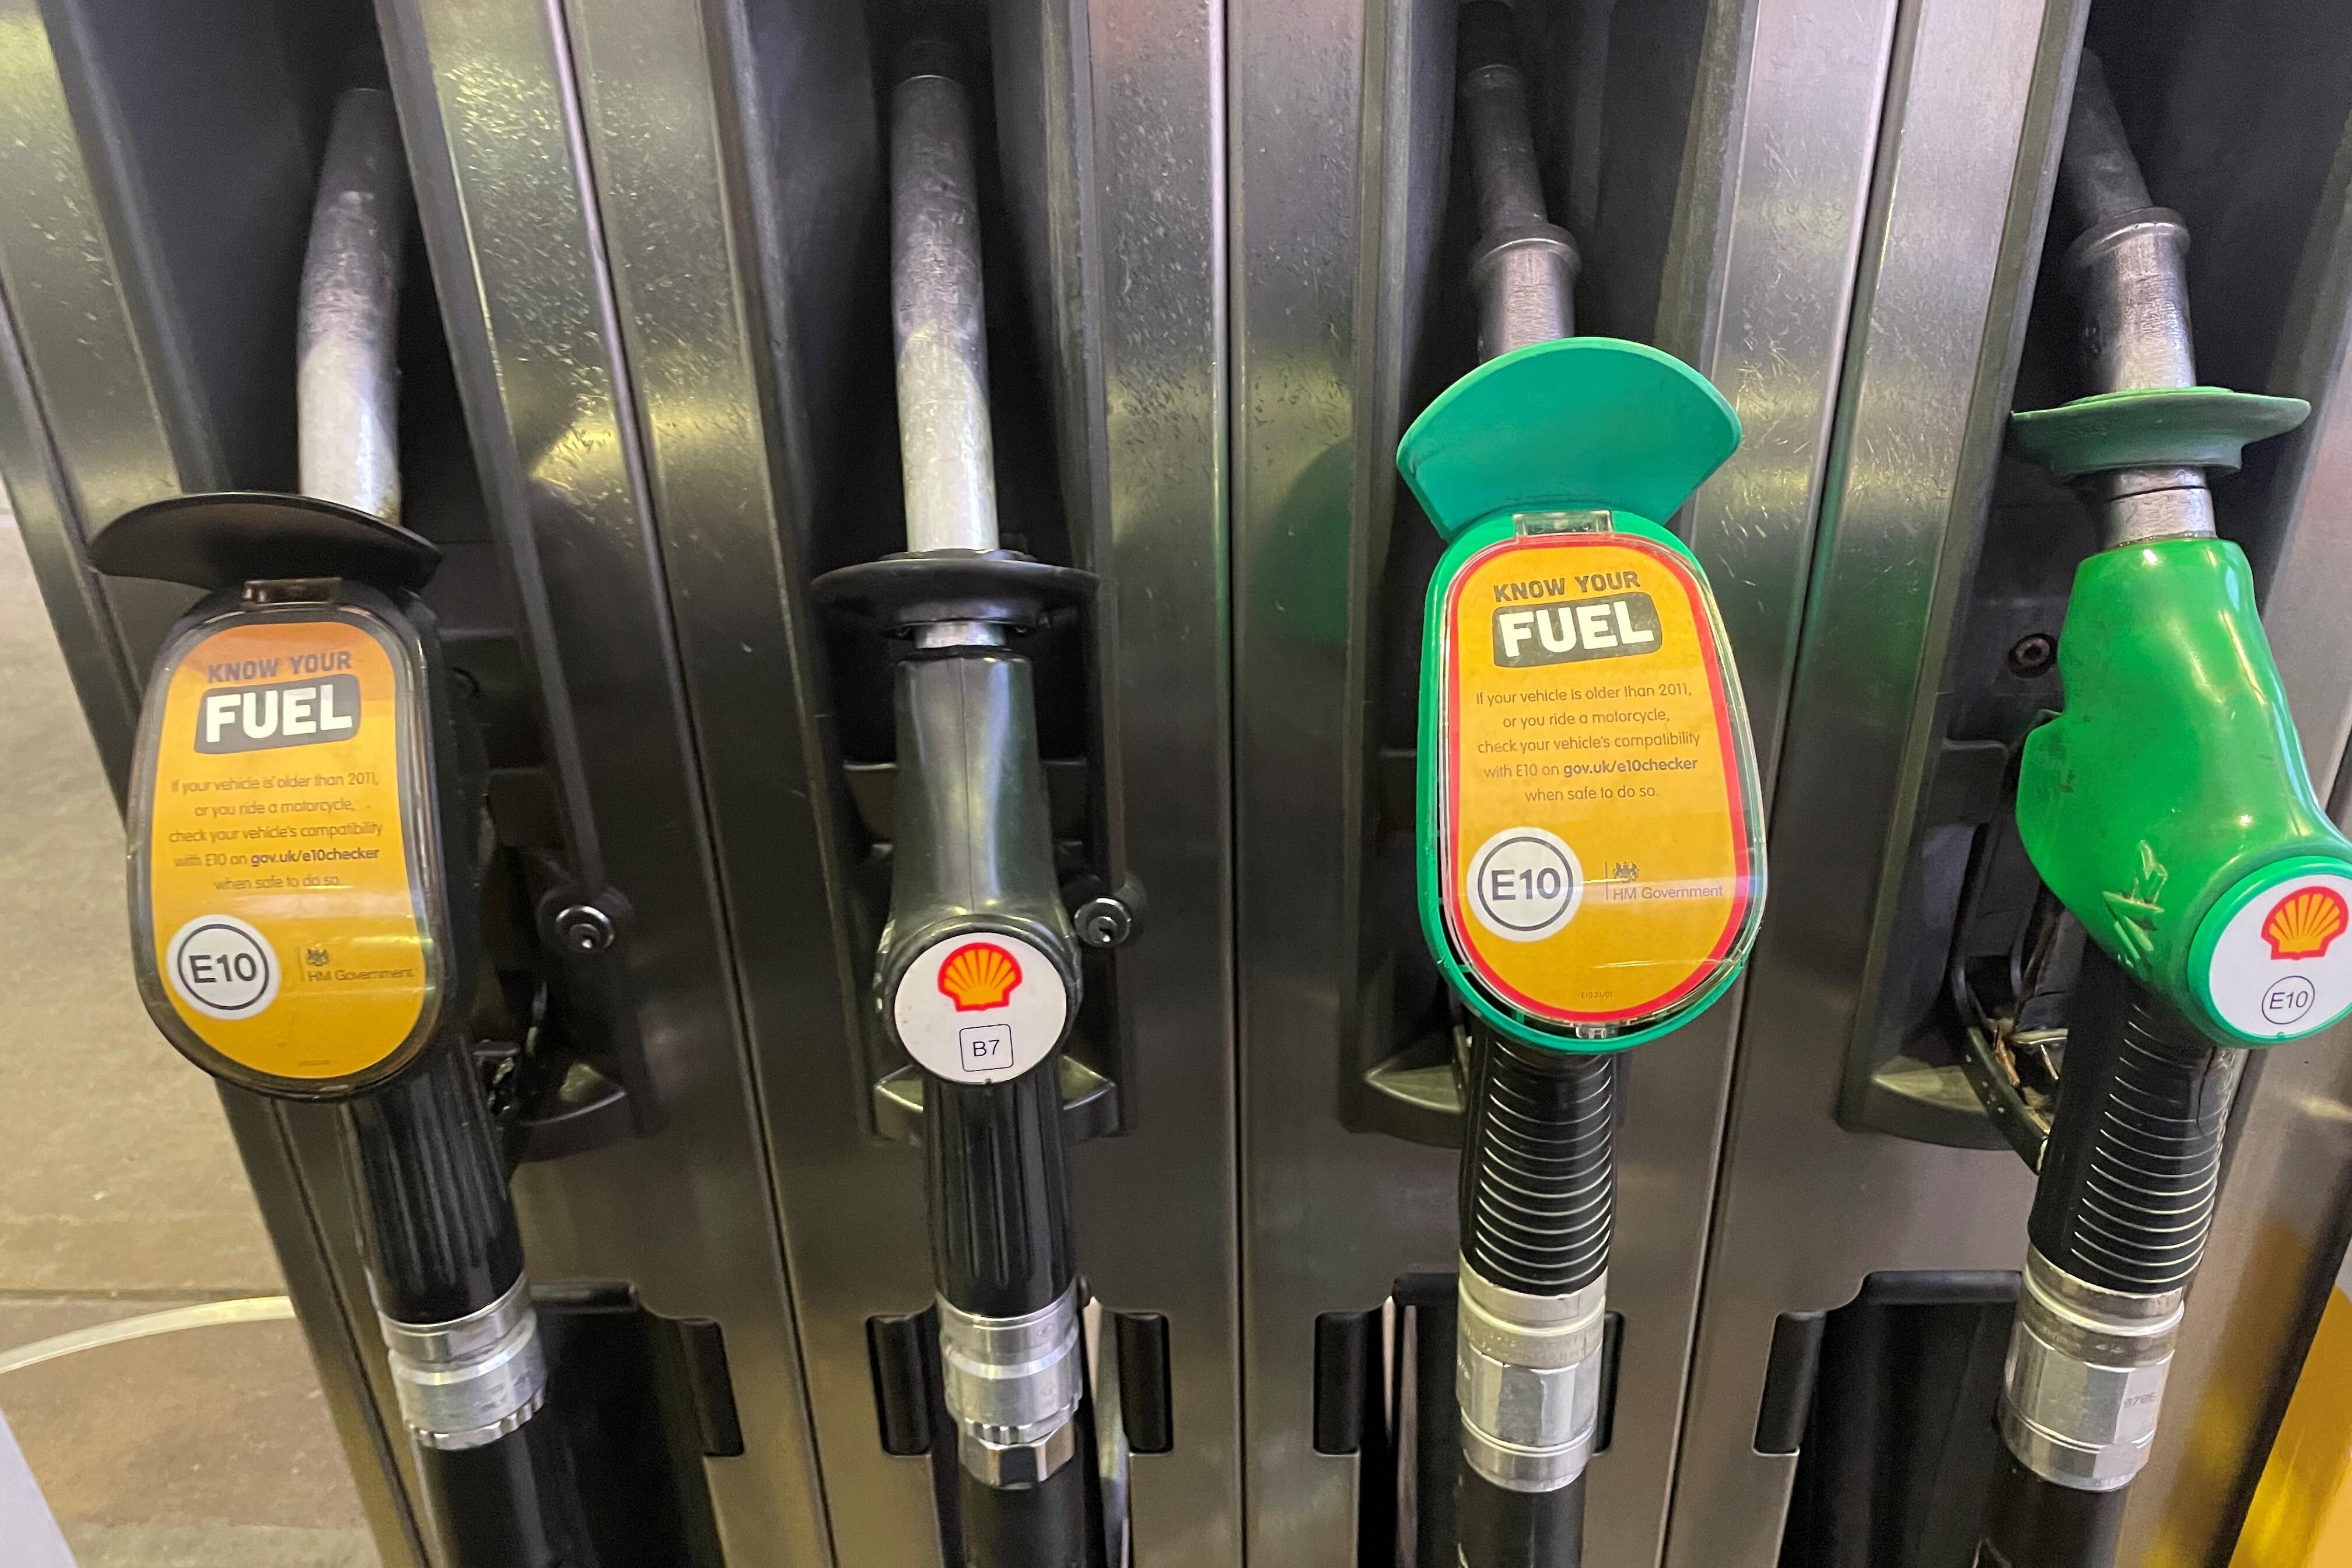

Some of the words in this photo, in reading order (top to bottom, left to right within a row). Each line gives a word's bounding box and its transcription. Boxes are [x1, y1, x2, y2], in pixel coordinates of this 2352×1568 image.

[1493, 578, 1566, 603] KNOW
[1574, 570, 1641, 594] YOUR
[1498, 600, 1654, 657] FUEL
[207, 658, 279, 684] KNOW
[291, 650, 352, 674] YOUR
[1476, 691, 1484, 705] If
[1486, 693, 1517, 707] your
[1520, 688, 1567, 702] vehicle
[1570, 688, 1582, 700] is
[1586, 686, 1620, 699] older
[1624, 685, 1655, 698] than
[1658, 682, 1692, 696] 2011,
[206, 684, 352, 743] FUEL
[1503, 717, 1517, 727] or
[1520, 716, 1545, 730] you
[1549, 712, 1576, 725] ride
[1578, 714, 1588, 724] a
[1592, 708, 1670, 724] motorcycle,
[1478, 738, 1518, 753] check
[1520, 741, 1550, 754] your
[1553, 735, 1610, 750] vehicle's
[1614, 731, 1700, 749] compatibility
[1483, 764, 1512, 778] with
[1516, 764, 1538, 777] E10
[1542, 765, 1559, 776] on
[1563, 757, 1698, 778] gov.uk/e10checker
[277, 774, 312, 788] older
[314, 773, 344, 786] than
[1524, 788, 1563, 802] when
[1567, 786, 1597, 800] safe
[1600, 787, 1613, 799] to
[1617, 785, 1635, 798] do
[1639, 787, 1660, 797] so.
[211, 806, 236, 818] you
[268, 803, 277, 813] a
[169, 829, 206, 843] check
[209, 830, 240, 844] your
[230, 855, 248, 865] on
[251, 847, 380, 867] gov.uk/e10checker
[214, 876, 252, 890] when
[255, 875, 284, 888] safe
[286, 876, 299, 887] to
[302, 874, 321, 887] do
[1491, 867, 1562, 901] E10
[1613, 887, 1637, 900] HM
[1641, 885, 1724, 900] Government
[188, 952, 257, 984] E10
[308, 970, 331, 982] HM
[334, 968, 416, 981] Government
[2269, 990, 2309, 1010] E10
[972, 1039, 1001, 1057] B7
